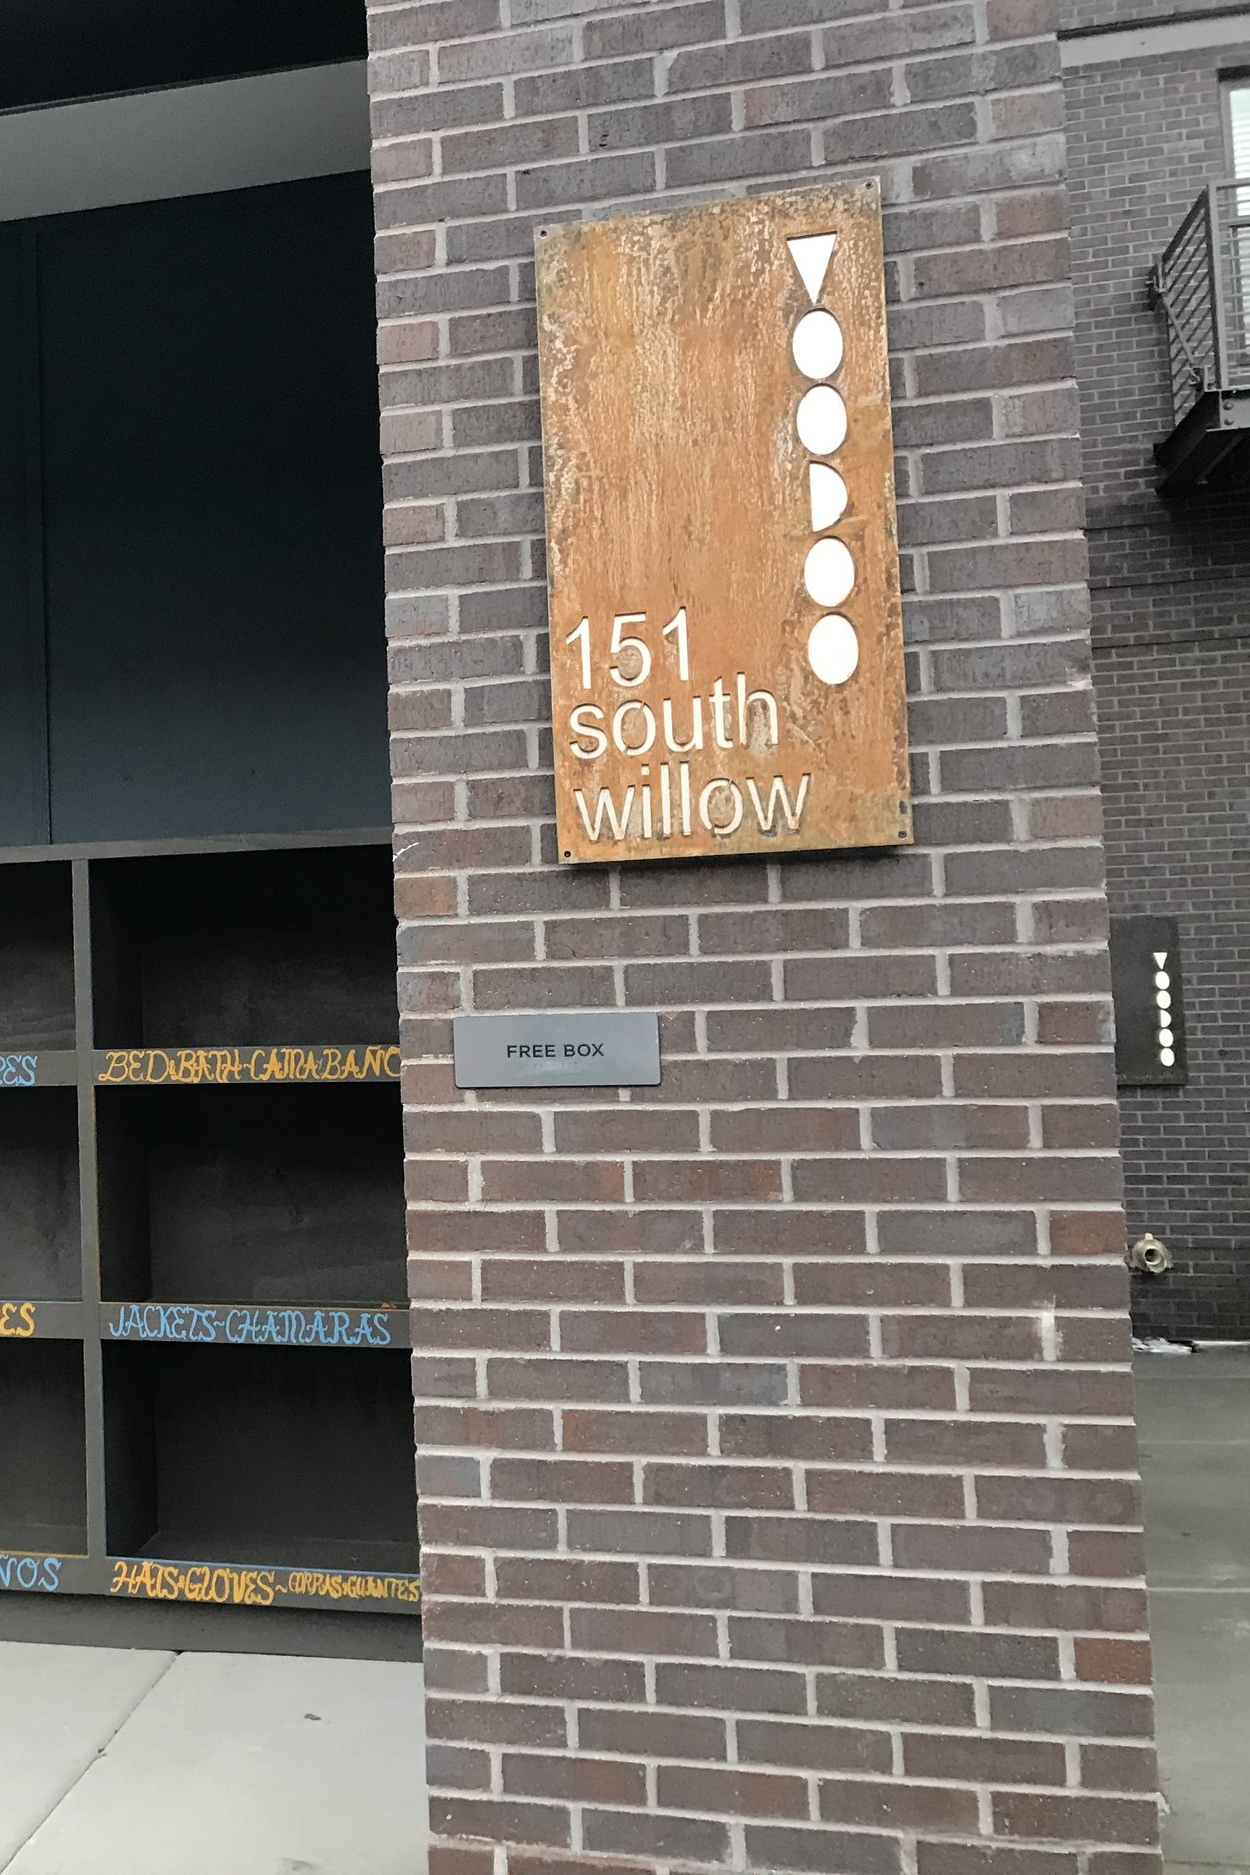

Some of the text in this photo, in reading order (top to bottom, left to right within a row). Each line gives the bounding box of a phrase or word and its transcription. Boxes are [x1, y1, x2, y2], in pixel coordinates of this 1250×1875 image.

[565, 606, 690, 690] 151
[569, 671, 780, 760] south
[573, 761, 812, 842] willow
[507, 1043, 605, 1058] FREE BOX
